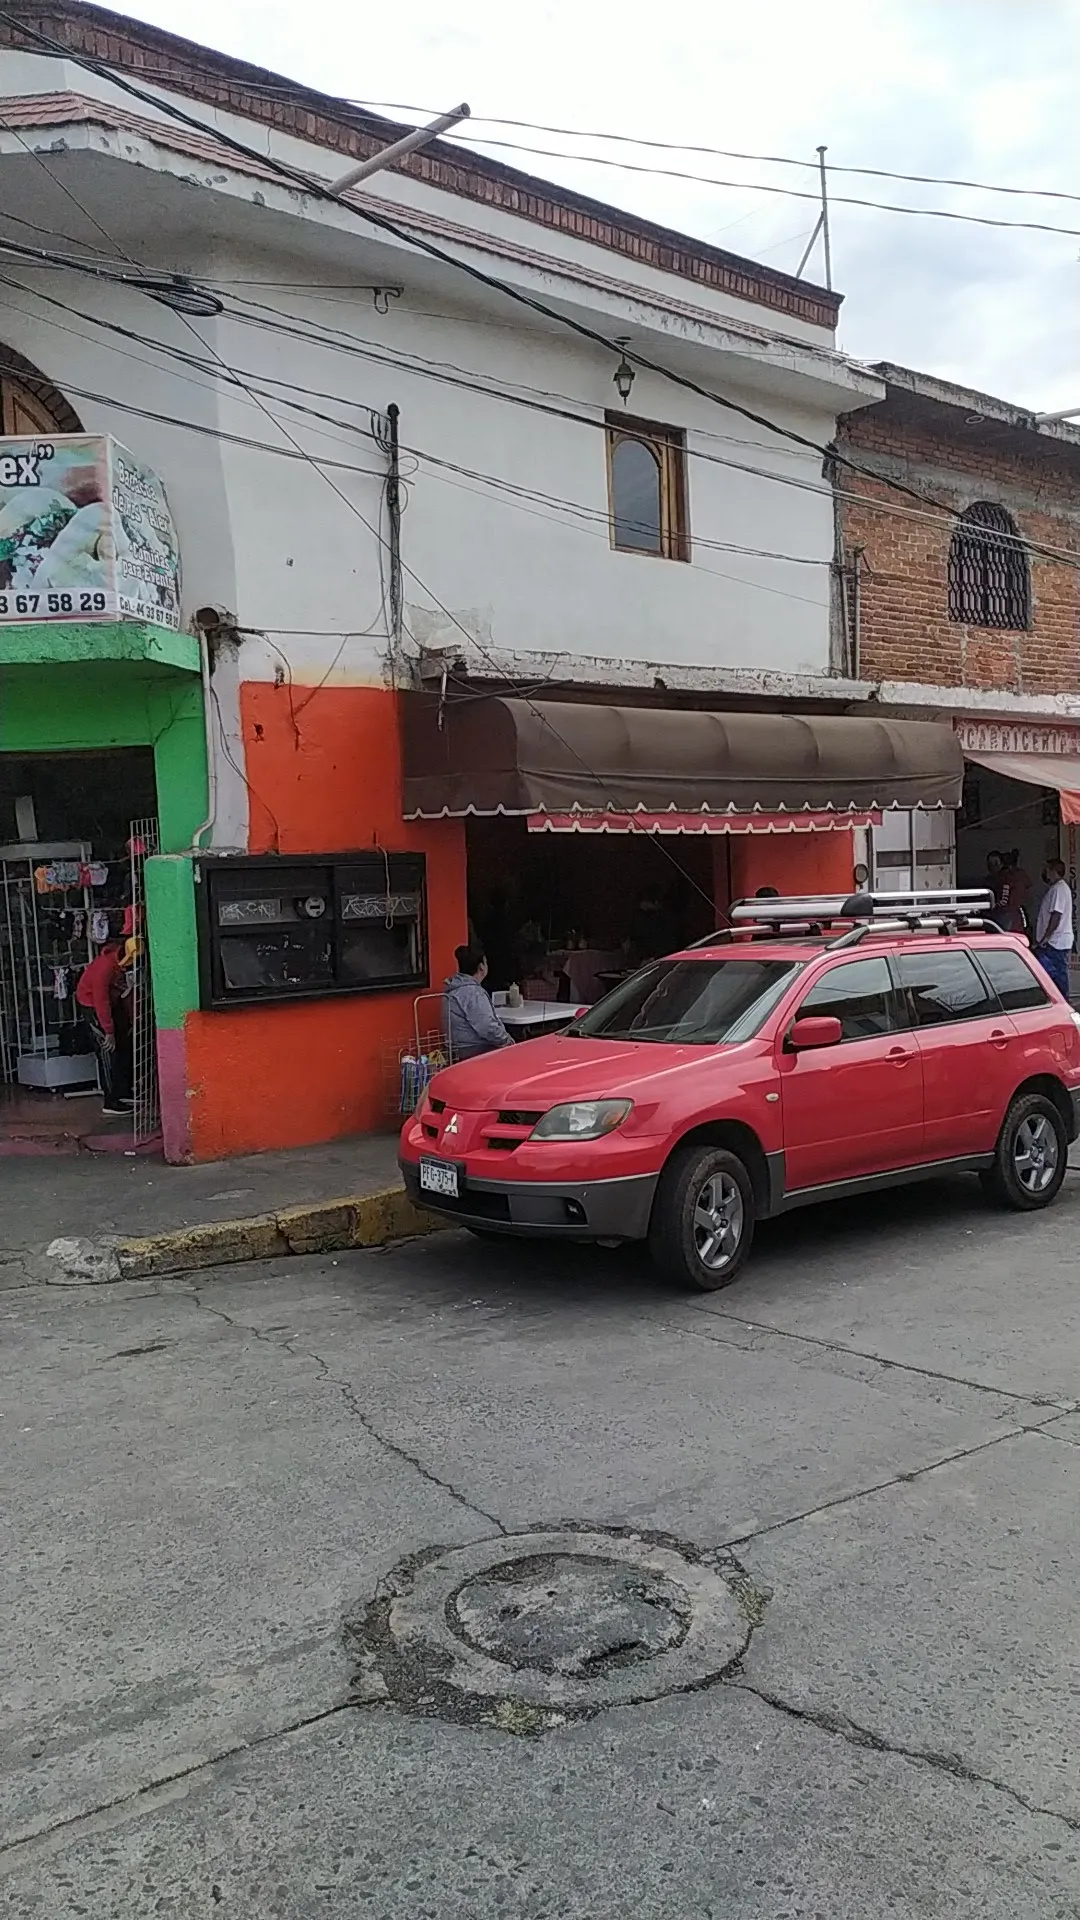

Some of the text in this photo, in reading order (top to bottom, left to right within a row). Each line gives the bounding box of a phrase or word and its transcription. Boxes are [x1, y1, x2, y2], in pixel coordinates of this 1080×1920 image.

[122, 559, 143, 580] para
[15, 595, 40, 613] 67
[47, 593, 73, 613] 58
[79, 592, 106, 612] 29
[146, 605, 155, 620] 33
[156, 609, 164, 622] 67
